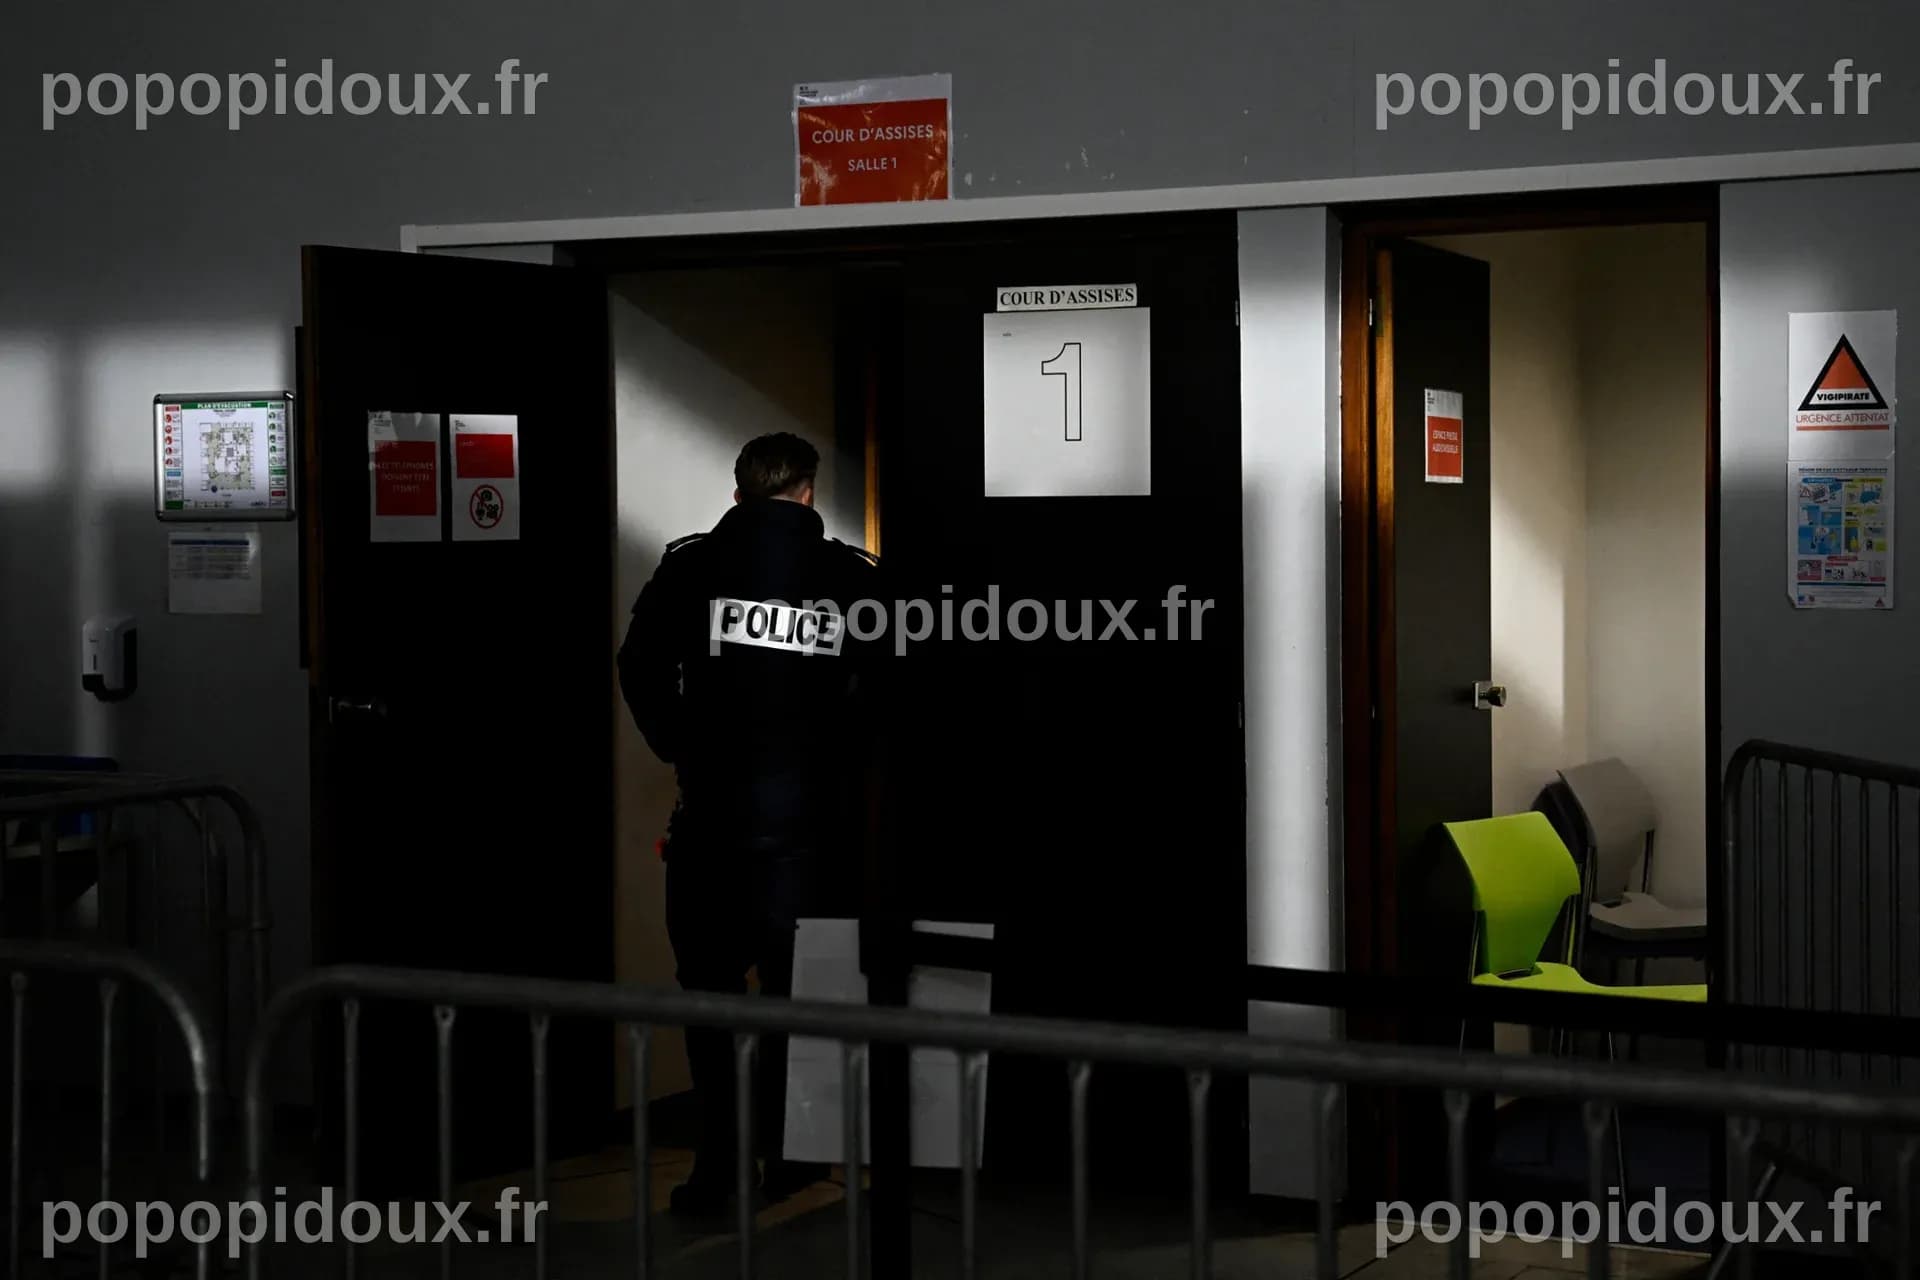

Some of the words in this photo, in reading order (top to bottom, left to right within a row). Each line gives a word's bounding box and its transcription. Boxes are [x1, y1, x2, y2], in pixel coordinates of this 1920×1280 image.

[812, 129, 855, 144] COUR
[859, 124, 934, 142] D'ASSISES
[848, 158, 888, 172] SALLE
[891, 157, 897, 169] 1
[1000, 290, 1045, 306] COUR
[1050, 288, 1135, 304] D'ASSISES
[1041, 342, 1082, 441] 1
[1816, 392, 1870, 401] VIGIPIRATE
[1796, 413, 1842, 424] URGENCE
[1844, 412, 1889, 423] ATTENTAT
[720, 600, 839, 650] POLICE
